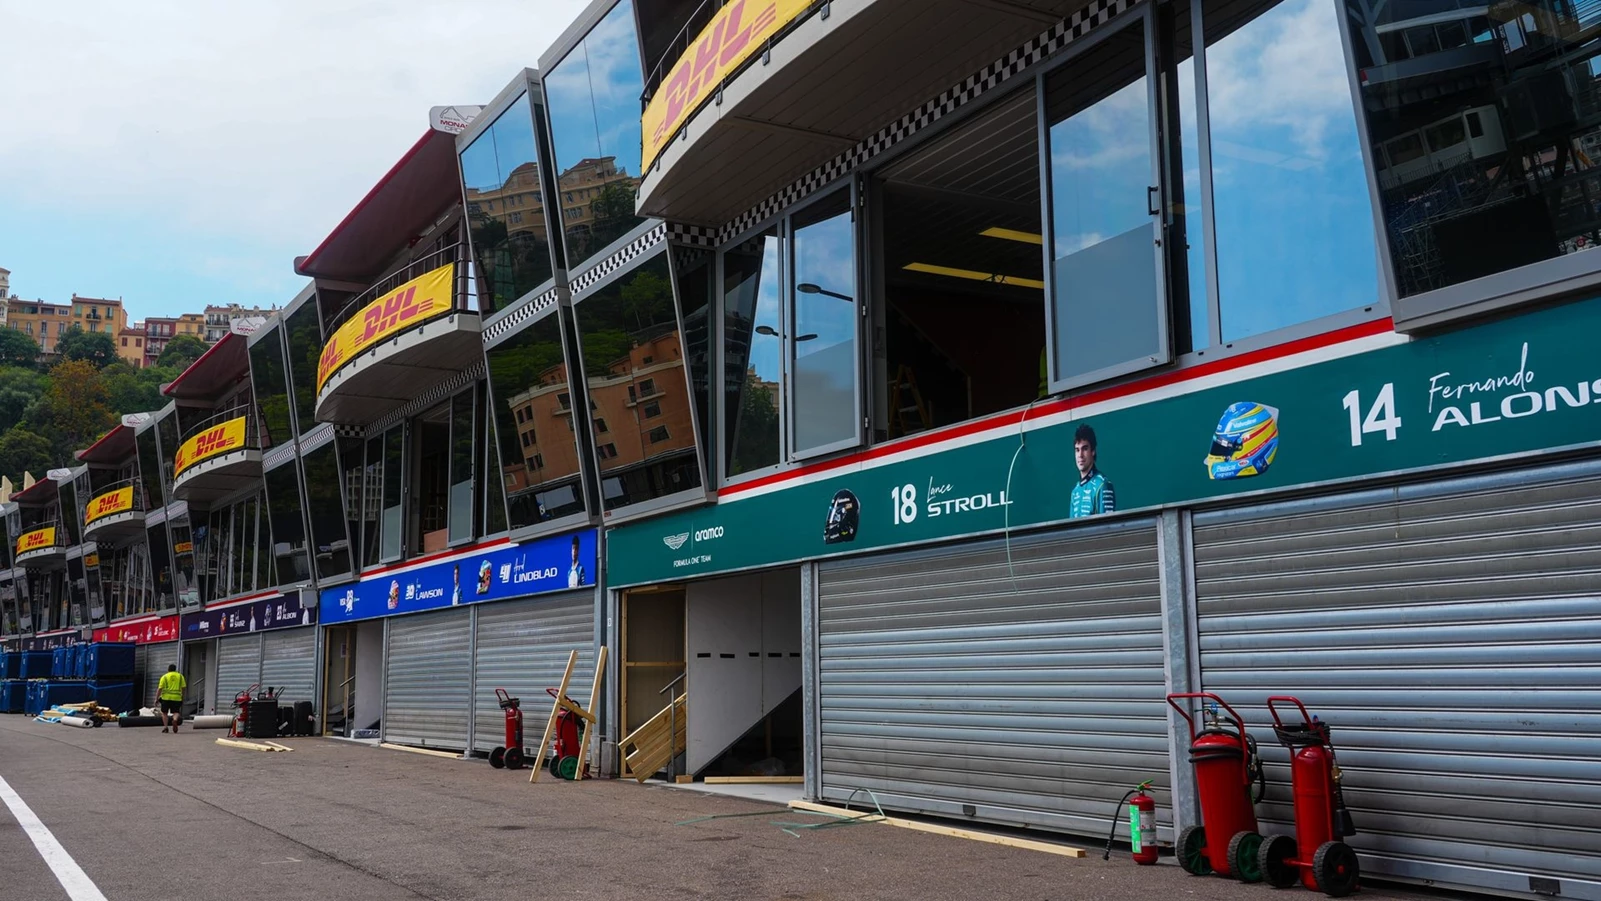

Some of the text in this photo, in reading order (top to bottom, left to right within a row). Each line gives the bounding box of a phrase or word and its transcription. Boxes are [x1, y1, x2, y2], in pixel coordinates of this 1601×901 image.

[664, 0, 753, 132] DHL
[363, 285, 420, 342] DHL
[1428, 342, 1535, 414] Fernando
[1342, 378, 1601, 447] 14 ALON
[195, 426, 227, 457] DHL
[98, 493, 121, 513] DHL
[927, 476, 954, 503] Lance
[891, 483, 1014, 525] 18 STROLL
[27, 531, 45, 547] DHL
[694, 525, 724, 542] aramco
[673, 558, 691, 568] FORMULA
[700, 554, 712, 563] TEAM
[514, 567, 558, 583] LINDBLAD
[416, 588, 444, 601] LAWSON
